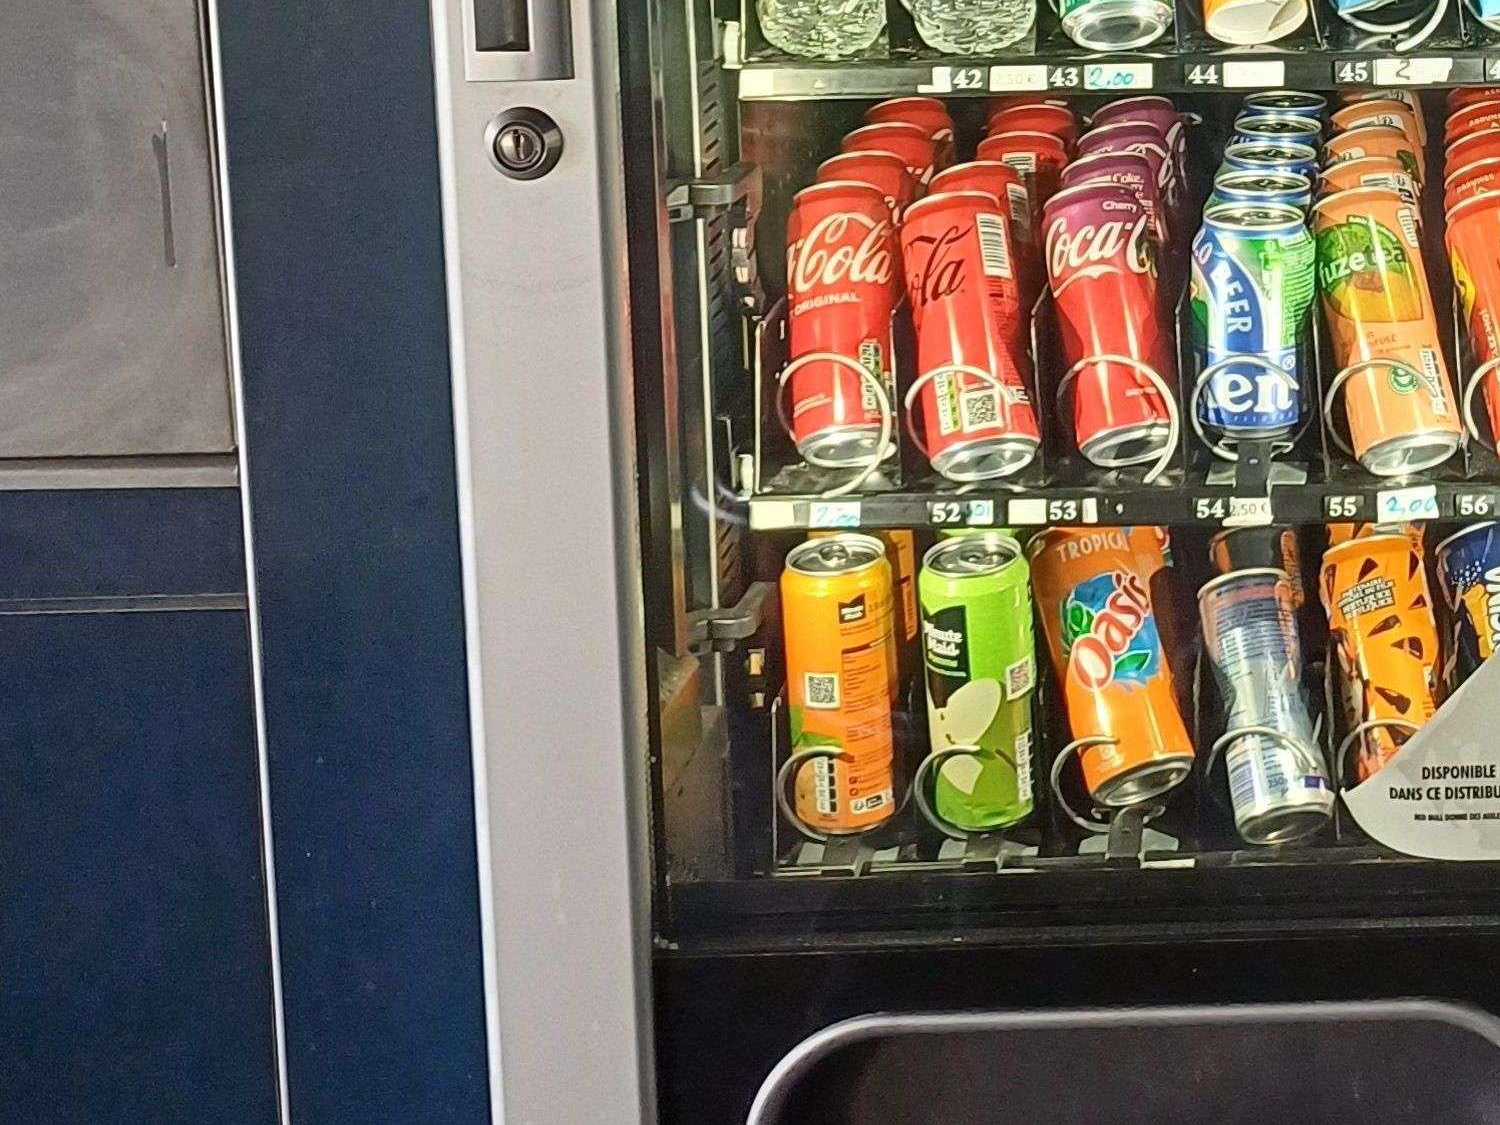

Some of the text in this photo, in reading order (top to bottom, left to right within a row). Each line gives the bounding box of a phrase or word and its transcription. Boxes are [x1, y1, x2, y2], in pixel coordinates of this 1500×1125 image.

[952, 70, 983, 88] 42
[1050, 67, 1079, 87] 43
[1188, 65, 1219, 85] 44
[1338, 62, 1368, 82] 45
[1102, 200, 1137, 213] Cherry
[794, 292, 861, 316] ORIGINAL
[932, 502, 961, 523] 52
[1050, 501, 1077, 520] 53
[1196, 499, 1225, 519] 54
[1330, 498, 1357, 517] 55
[1461, 495, 1489, 515] 56
[1056, 531, 1130, 563] TROPICA
[1075, 571, 1151, 688] Oasis
[1422, 764, 1496, 780] DISPONIBLE
[1389, 786, 1422, 800] DANS
[1426, 786, 1441, 800] CE
